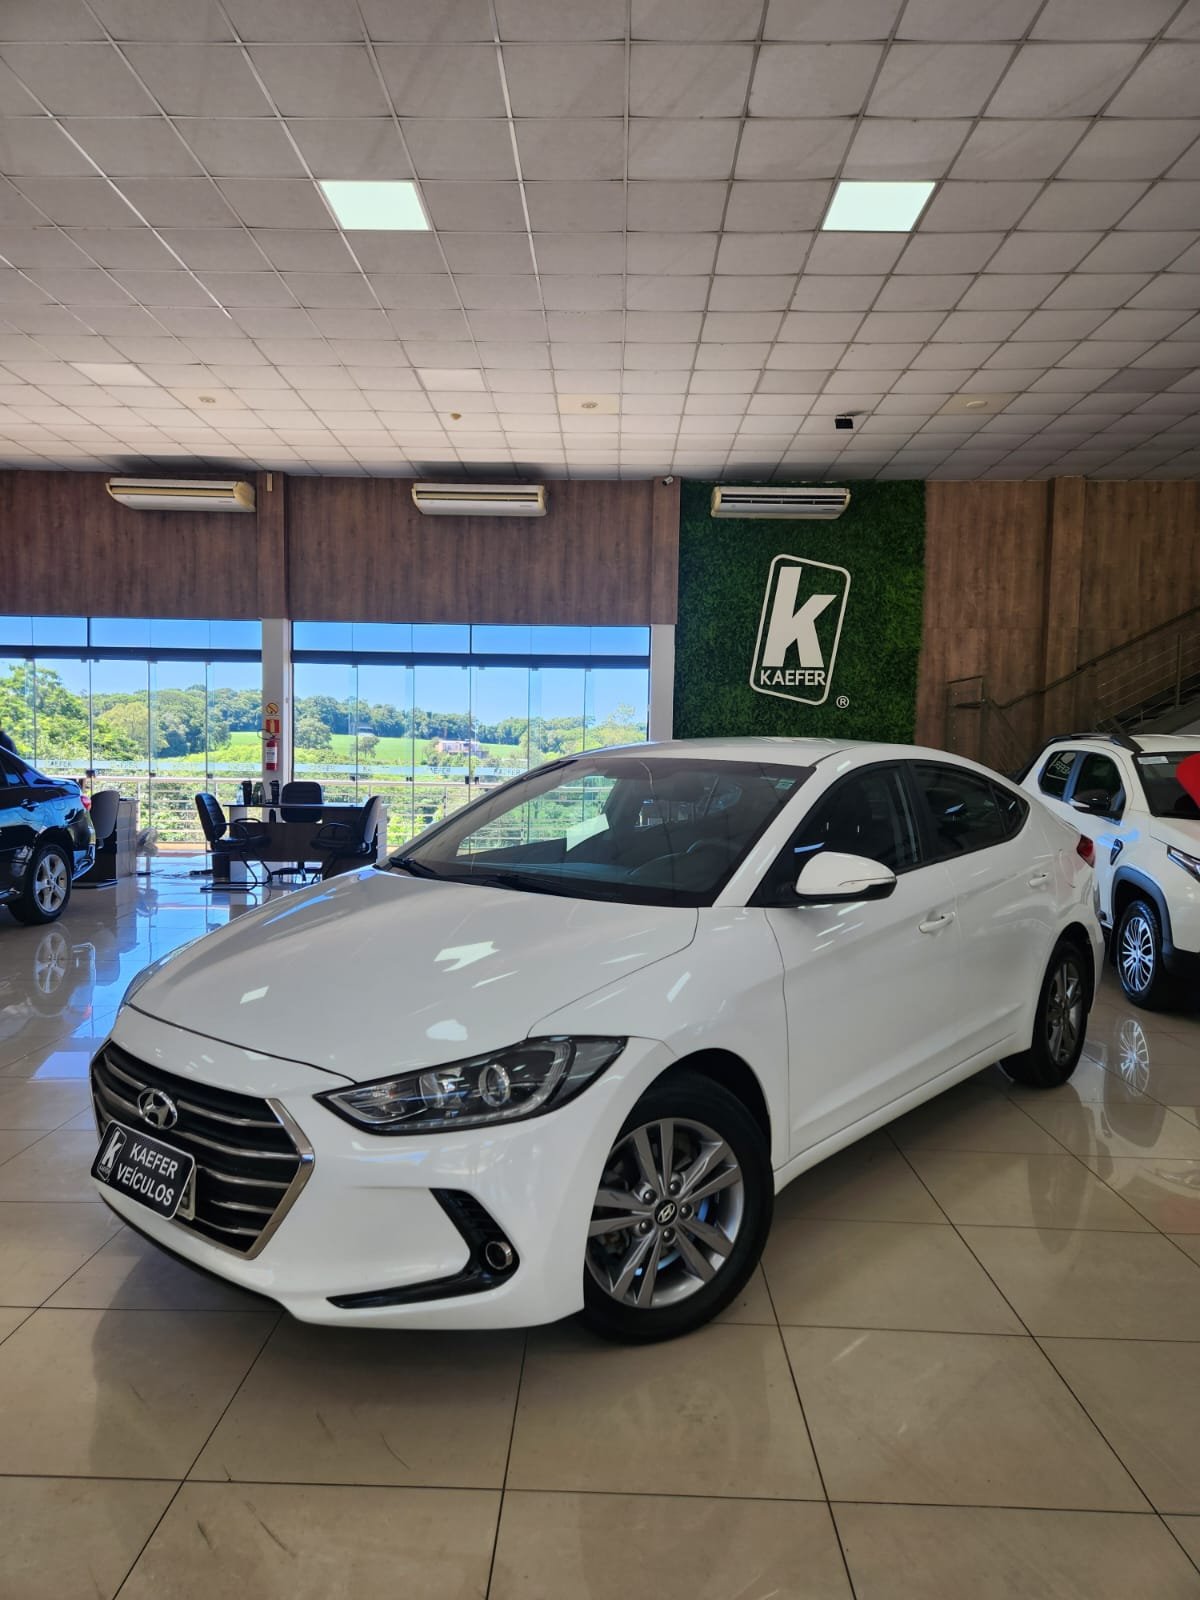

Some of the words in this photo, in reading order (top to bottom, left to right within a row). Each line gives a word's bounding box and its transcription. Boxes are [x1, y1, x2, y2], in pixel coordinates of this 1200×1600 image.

[760, 669, 826, 686] KAEFER
[129, 1142, 178, 1180] KAEFER
[116, 1162, 174, 1206] VEÍCULOS
